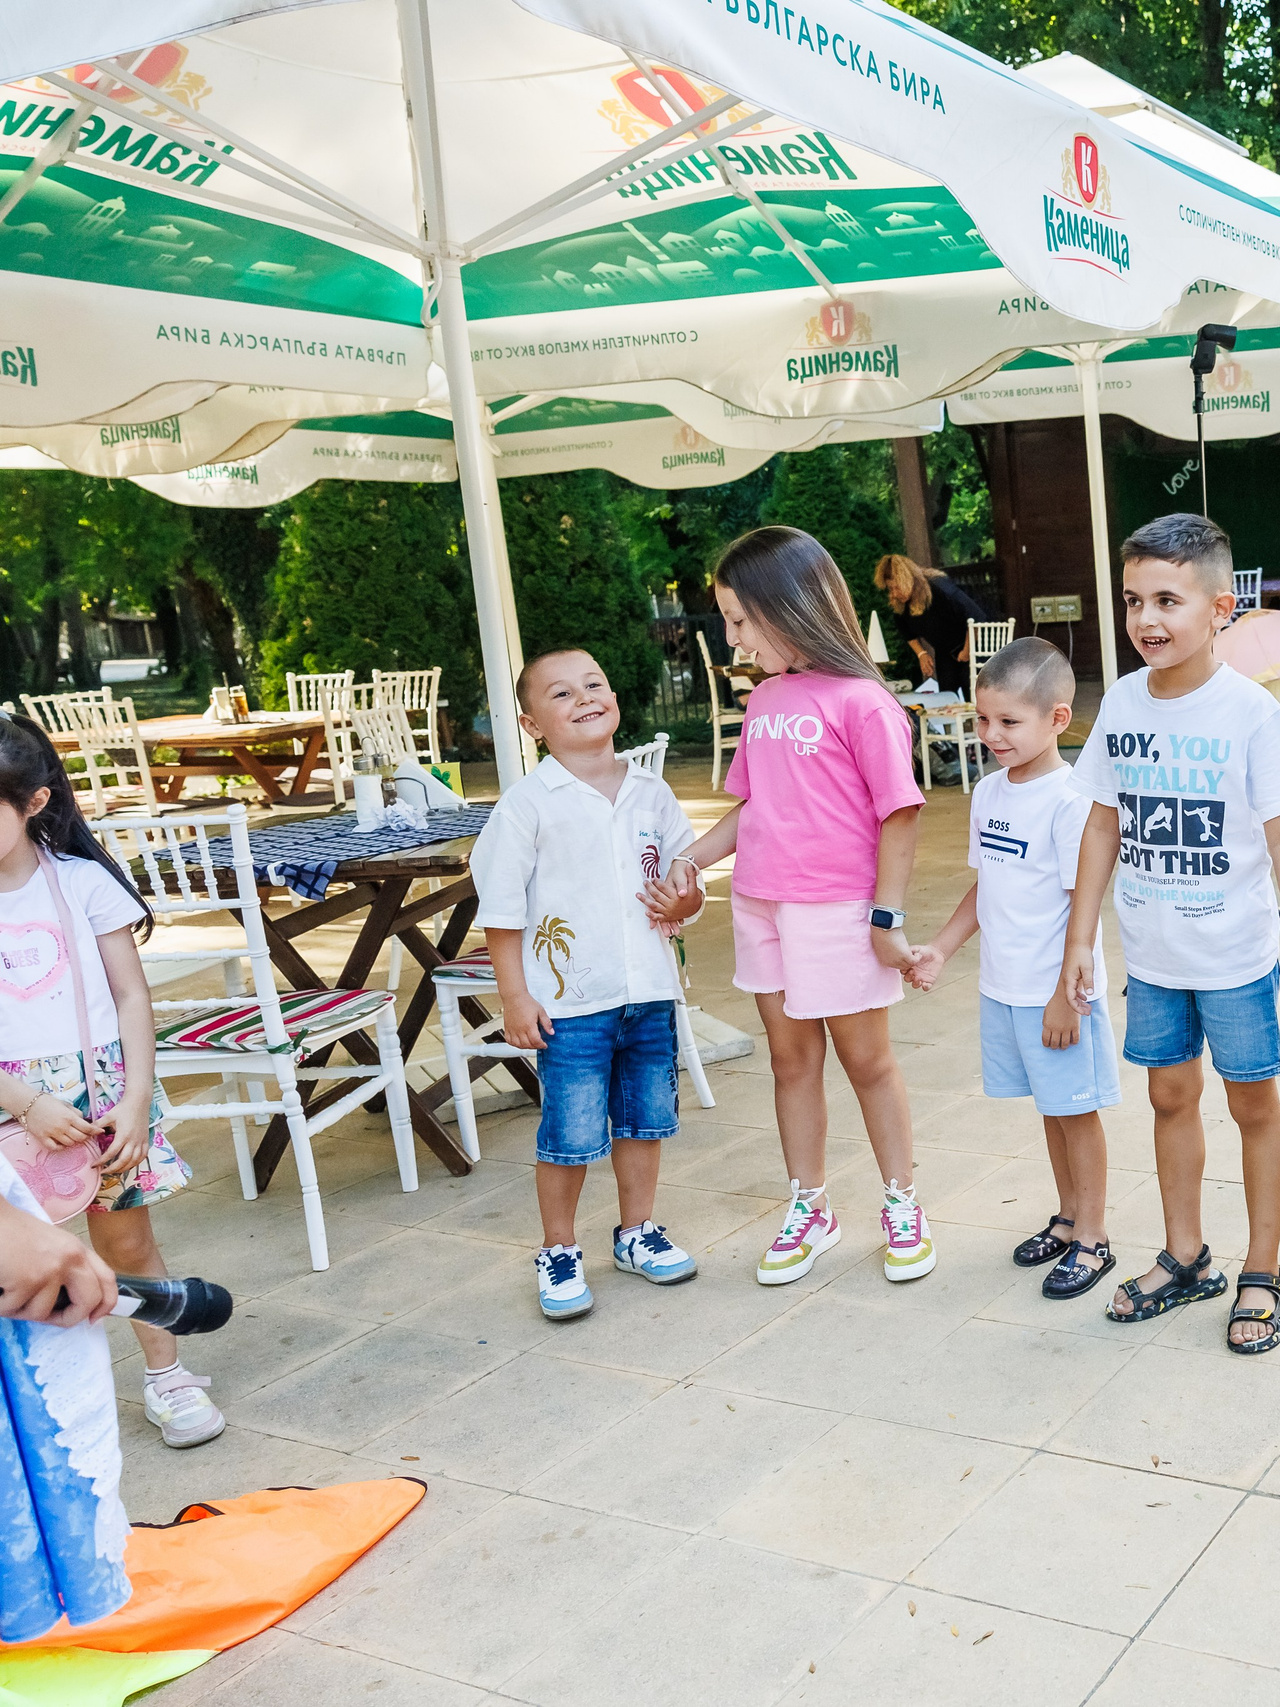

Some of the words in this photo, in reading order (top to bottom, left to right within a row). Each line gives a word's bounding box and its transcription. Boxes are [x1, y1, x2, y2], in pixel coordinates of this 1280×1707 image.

[888, 60, 946, 115] БИРА
[1043, 194, 1130, 274] Каменица
[1178, 204, 1185, 221] С
[1185, 207, 1241, 245] ОТЛИЧИТЕЛЕН
[1241, 230, 1271, 256] ХМЕЛОВ
[1162, 459, 1200, 495] love
[747, 713, 824, 745] PINKO
[794, 742, 819, 757] UP
[1106, 732, 1160, 763] BOY,
[1168, 734, 1231, 764] YOU
[1114, 763, 1225, 795] TOTALLY
[988, 818, 1010, 832] BOSS
[1119, 842, 1155, 872] GOT
[1159, 850, 1231, 876] THIS
[1138, 884, 1153, 898] DO
[1154, 888, 1179, 901] THE
[1180, 889, 1226, 903] WORK
[1147, 876, 1176, 885] YOURSELF
[3, 953, 41, 970] GUESS
